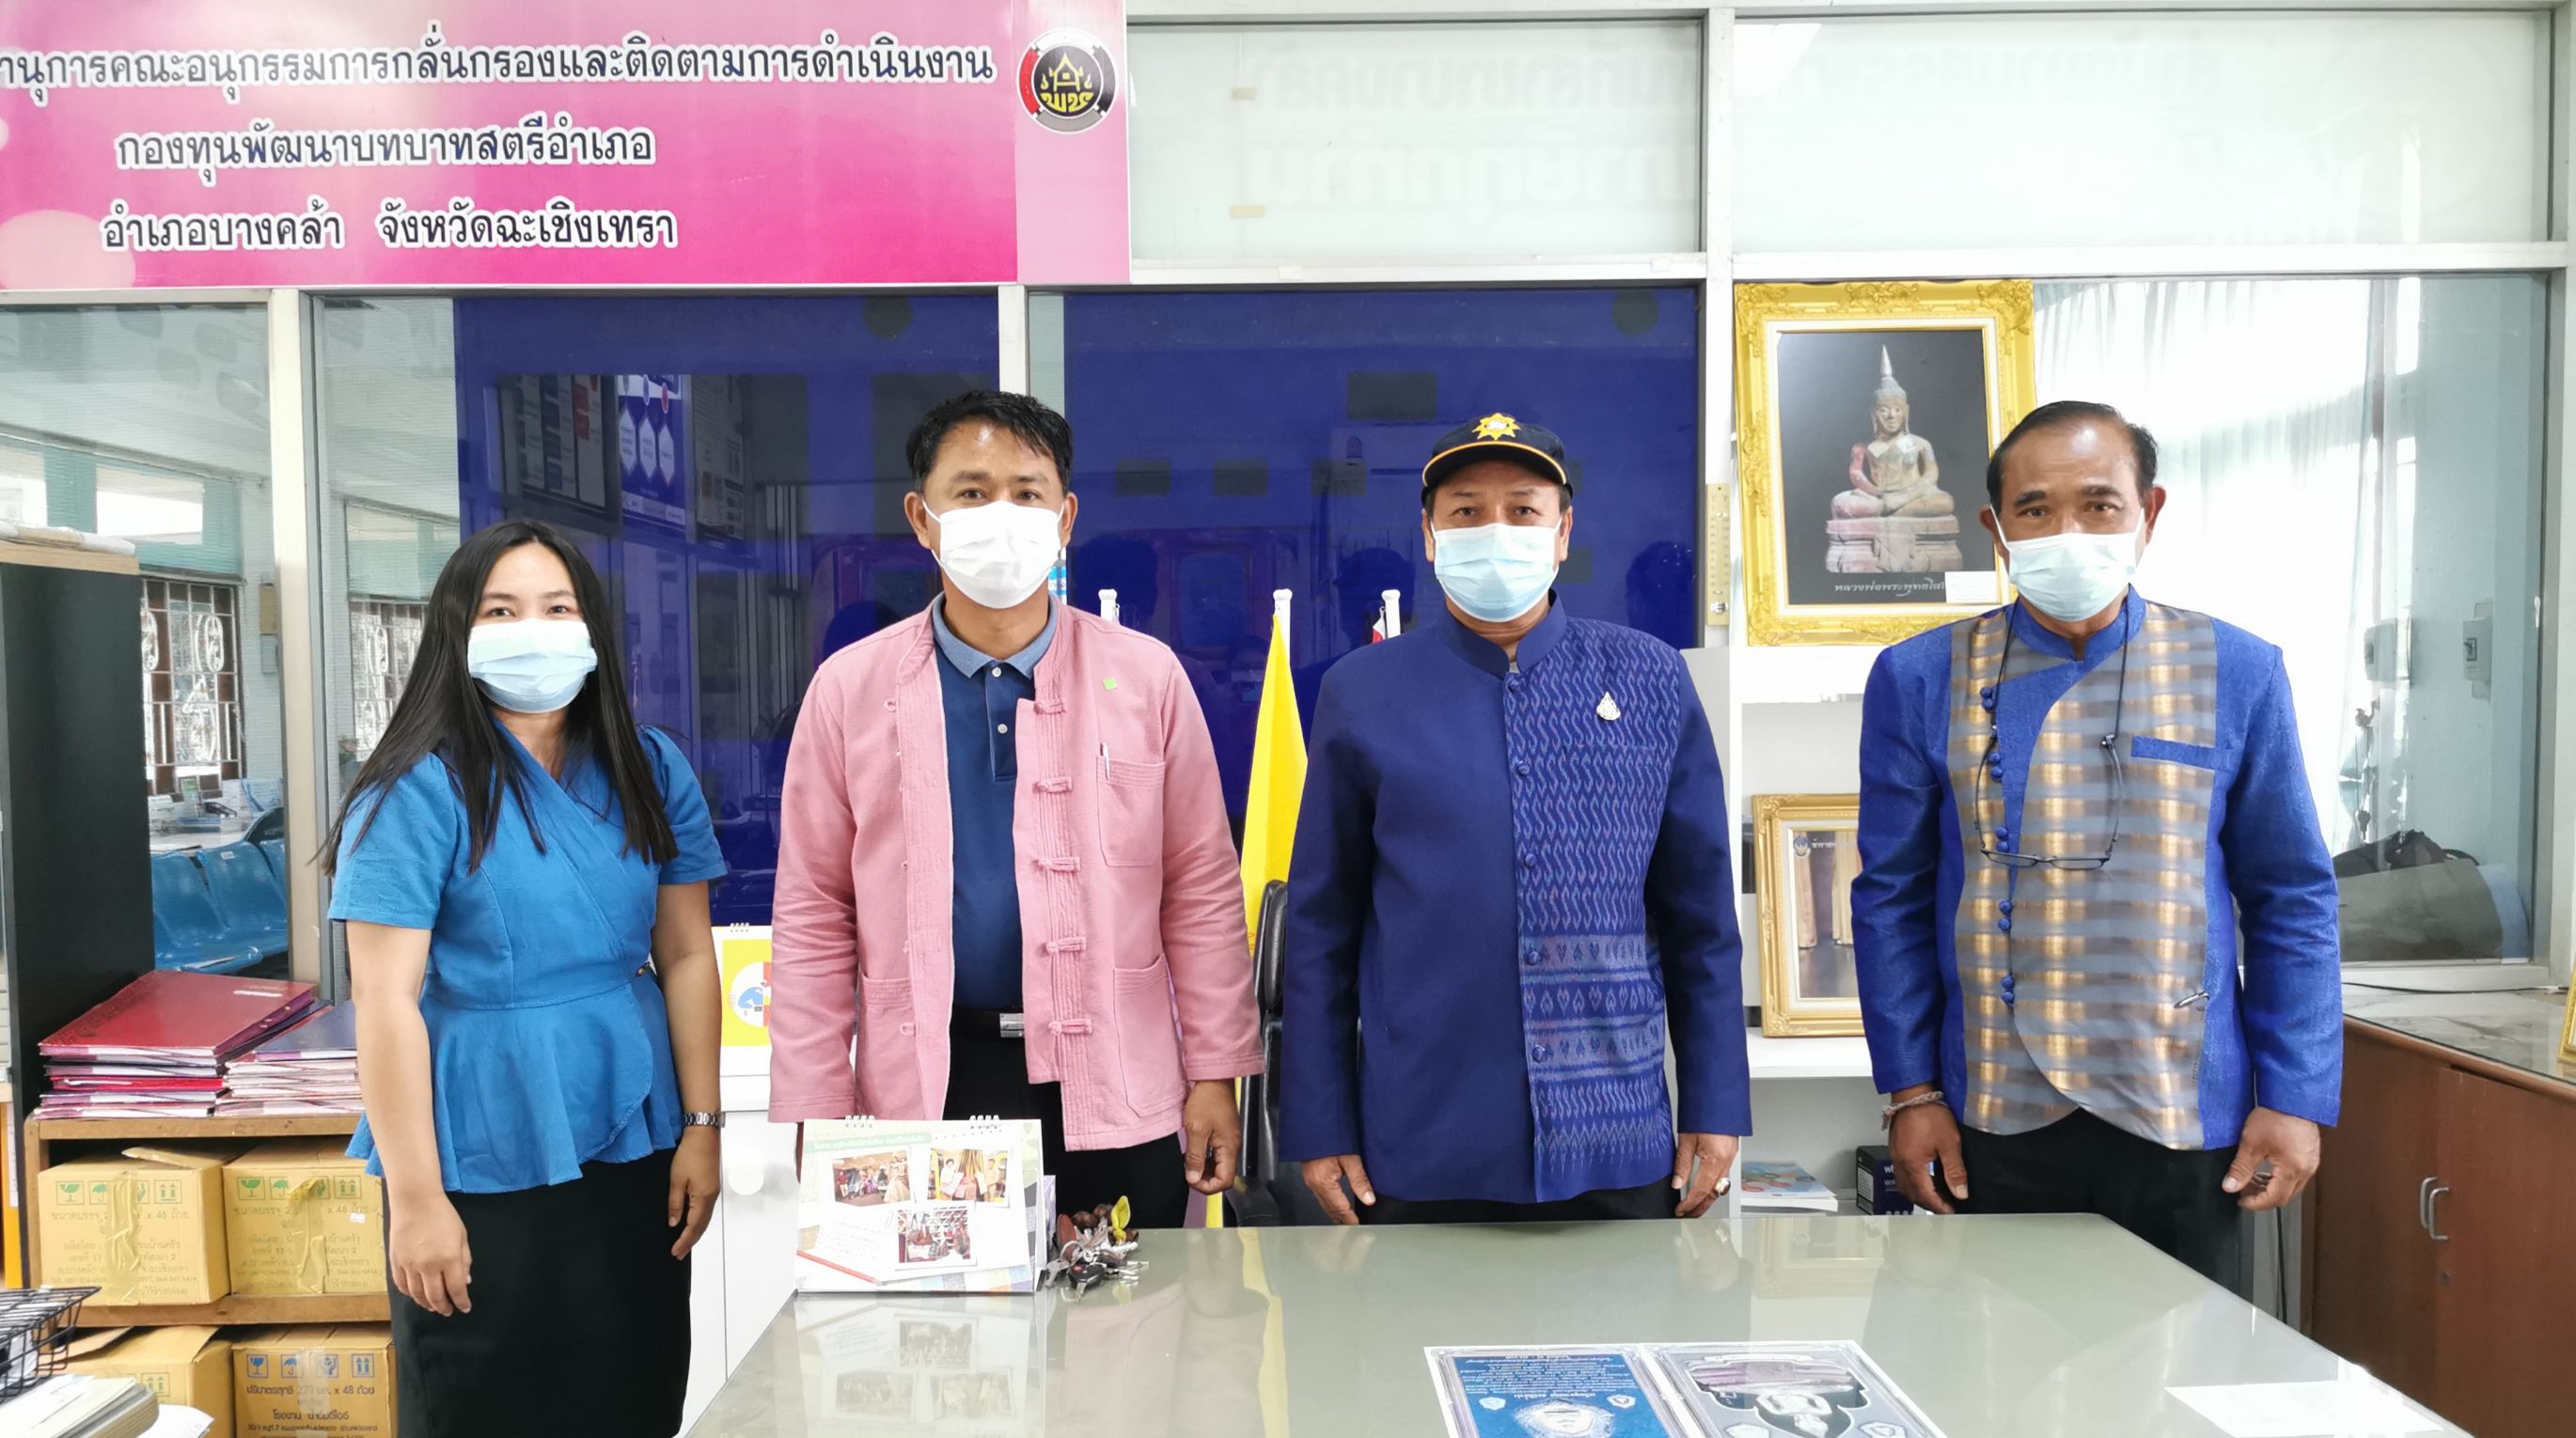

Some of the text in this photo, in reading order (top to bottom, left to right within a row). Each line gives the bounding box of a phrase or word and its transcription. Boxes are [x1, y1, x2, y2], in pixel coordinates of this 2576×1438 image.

[117, 115, 652, 182] กองทุนพัฒนาบทบาทสตรีอำเภอ
[103, 199, 674, 248] อำเภอบางคล้า จังหวัดฉะเชิงเทรา
[342, 1383, 354, 1396] 48
